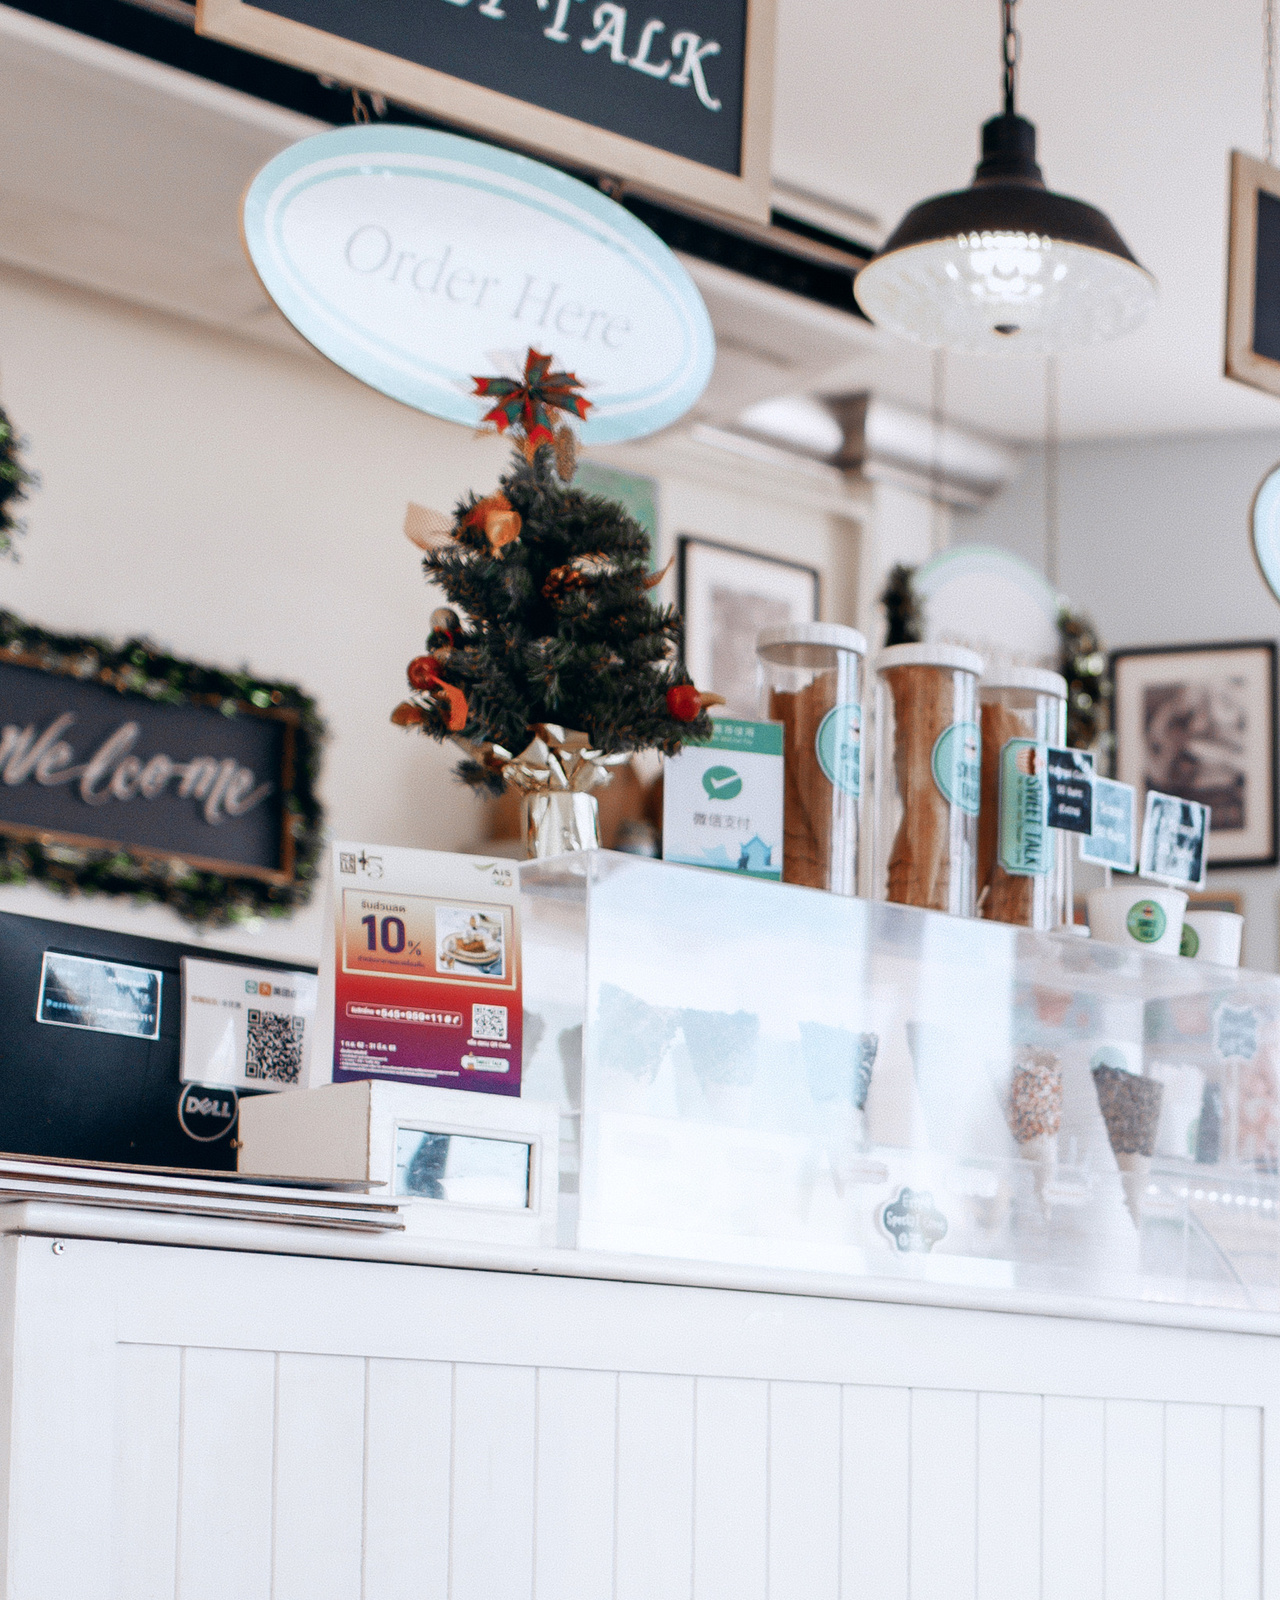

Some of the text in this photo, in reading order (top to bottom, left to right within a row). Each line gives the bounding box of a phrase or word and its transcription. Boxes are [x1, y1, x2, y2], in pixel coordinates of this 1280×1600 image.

[536, 0, 722, 112] TALK
[343, 222, 632, 350] Order Here
[185, 1095, 231, 1118] DELL
